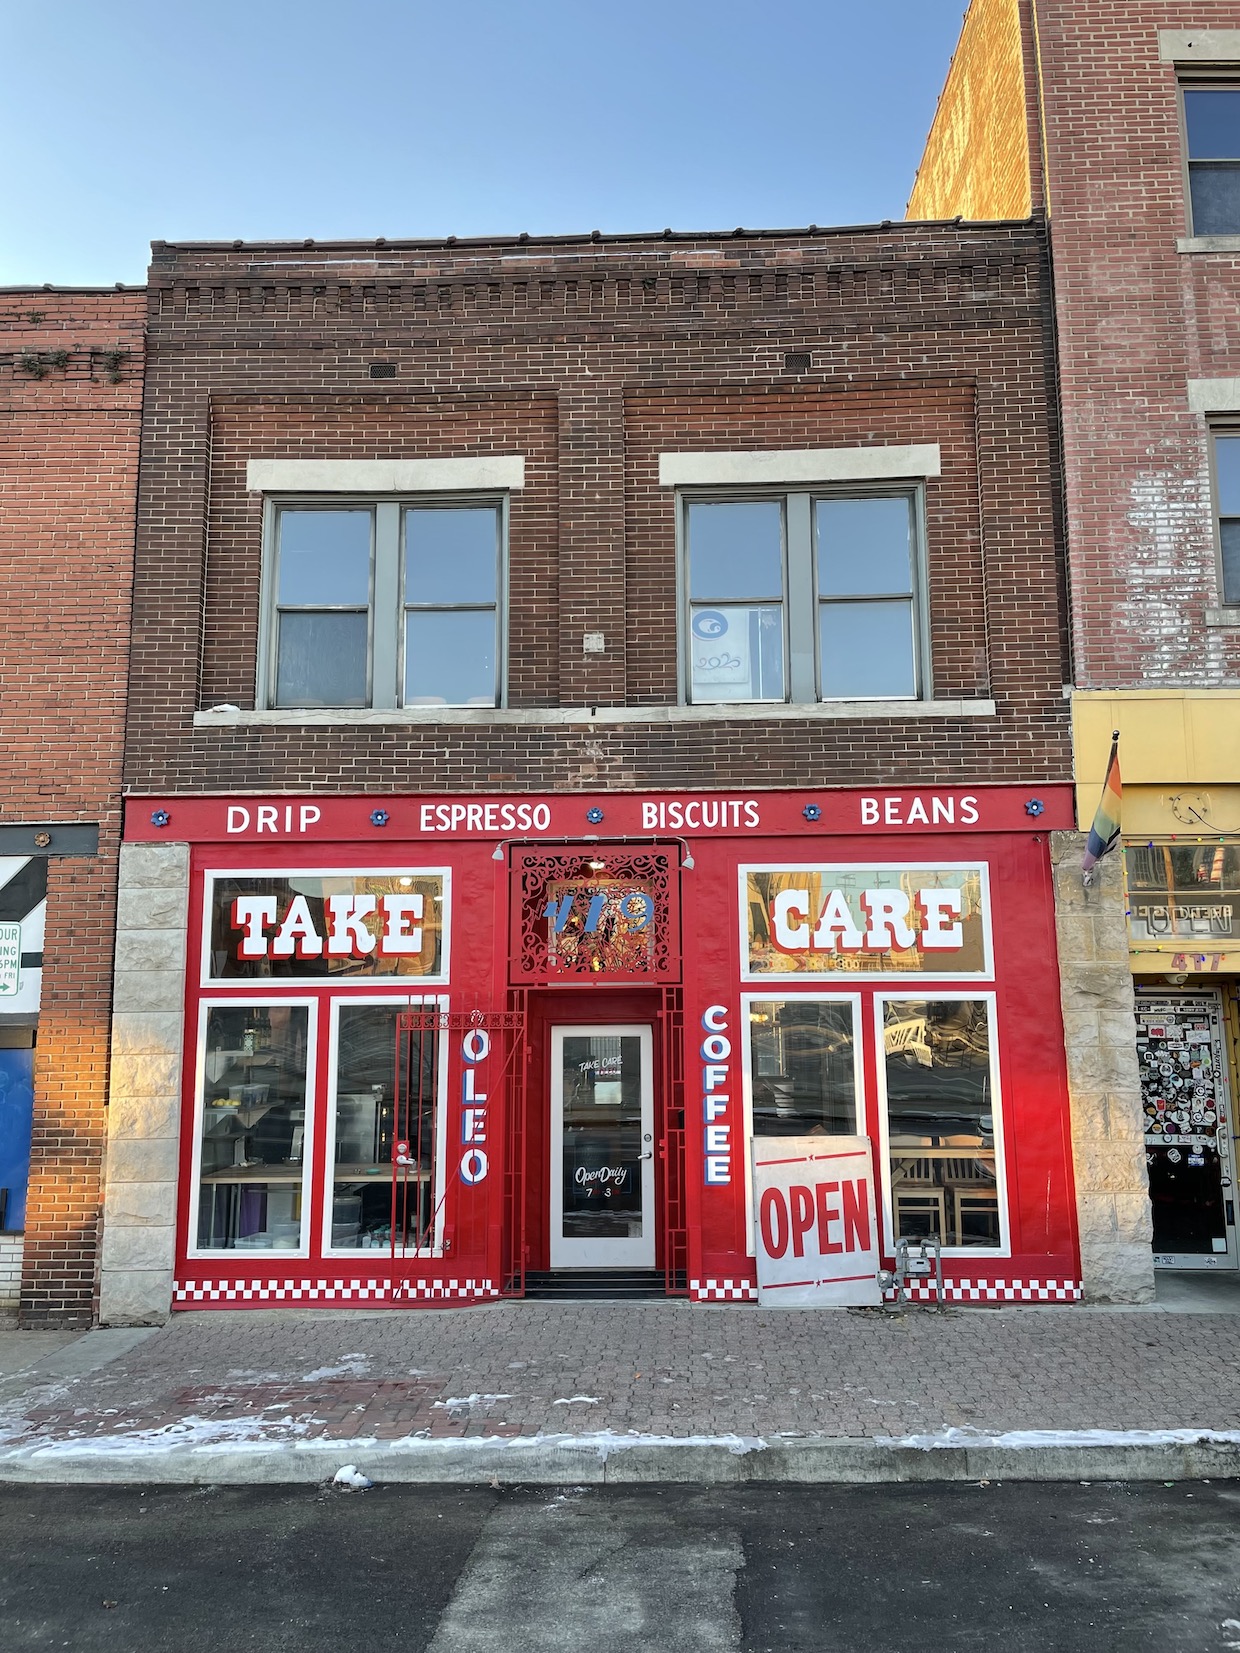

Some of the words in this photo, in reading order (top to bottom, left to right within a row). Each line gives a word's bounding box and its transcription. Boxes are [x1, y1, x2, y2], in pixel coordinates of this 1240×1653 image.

[227, 805, 321, 833] DRIP
[420, 803, 551, 832] ESPRESSO
[642, 801, 760, 829] BISCUITS
[860, 796, 980, 825] BEANS
[231, 894, 424, 960] TAKE
[543, 893, 655, 933] 419
[769, 889, 965, 953] CARE
[1151, 906, 1229, 933] OPEN
[1171, 953, 1220, 971] 417
[579, 1060, 600, 1072] TAKE
[601, 1056, 623, 1068] CARE
[701, 1005, 731, 1185] COFFEE
[760, 1178, 872, 1260] OPEN
